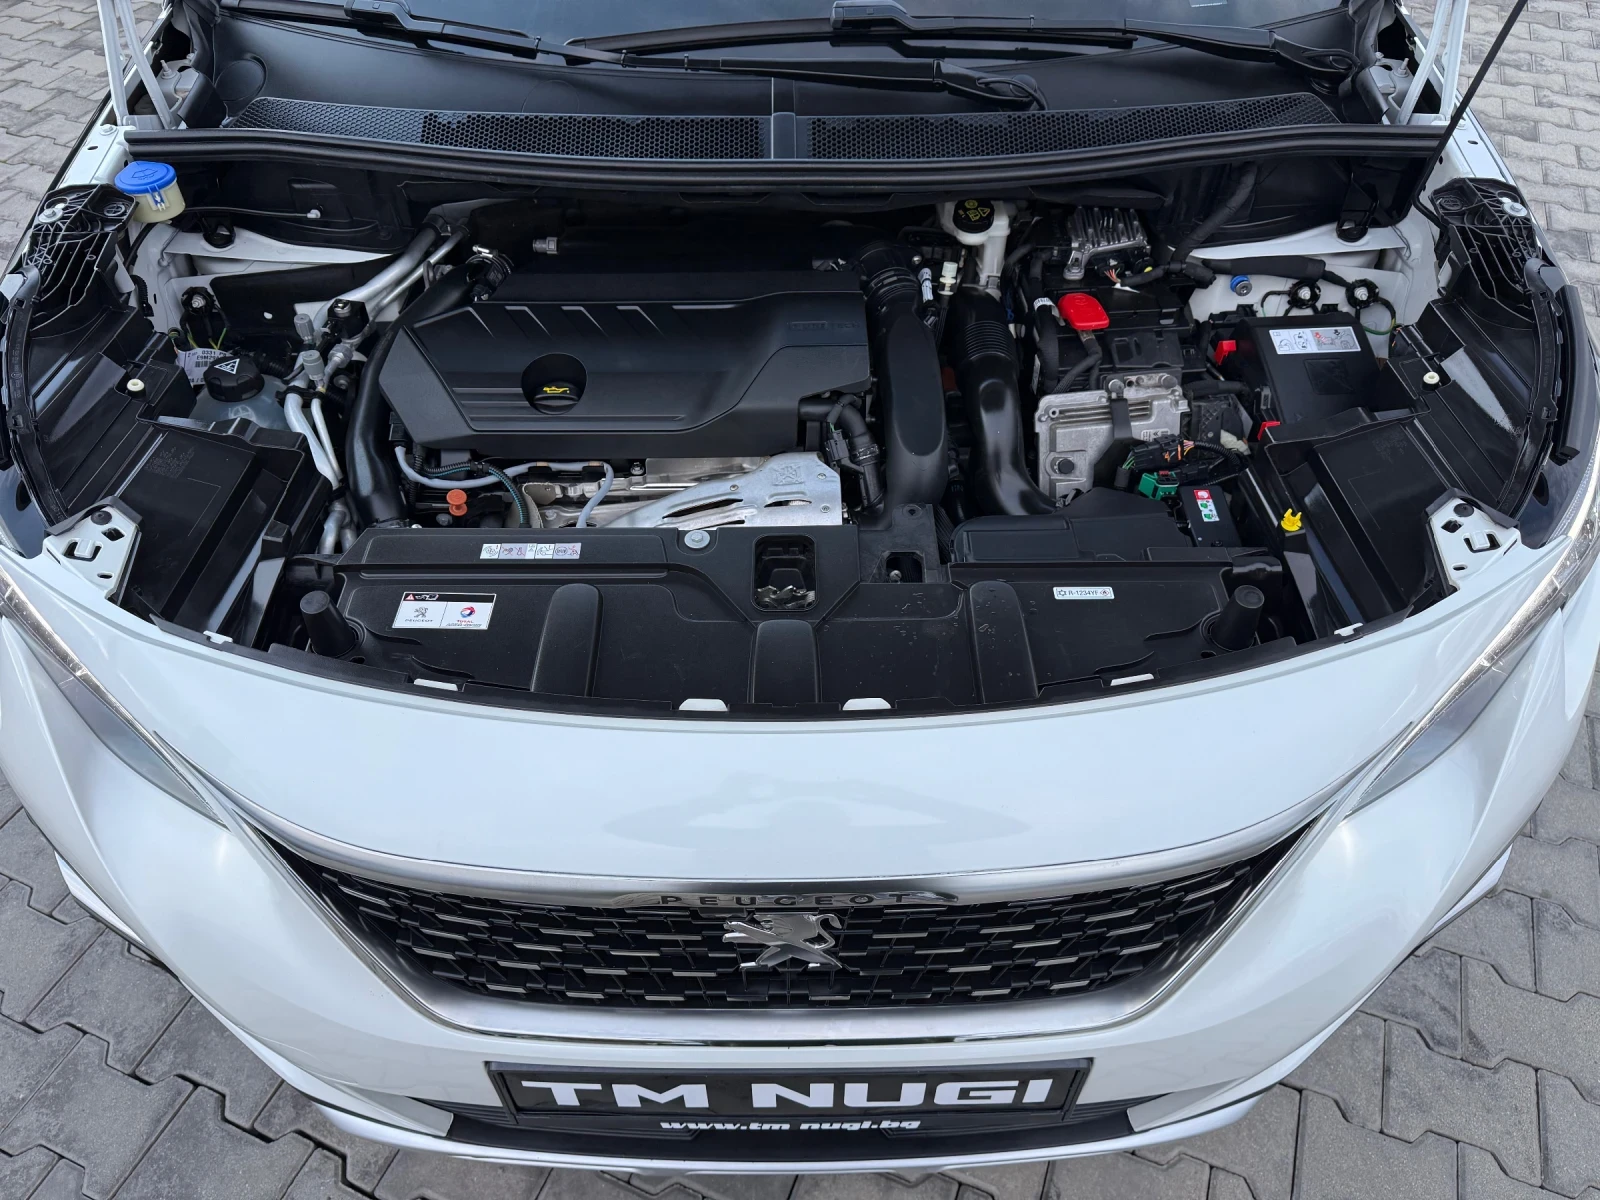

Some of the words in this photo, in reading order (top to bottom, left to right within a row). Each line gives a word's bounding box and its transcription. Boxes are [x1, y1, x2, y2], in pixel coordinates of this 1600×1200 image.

[660, 893, 911, 906] PEUGEOT
[521, 1080, 709, 1109] TM
[752, 1078, 1053, 1108] NUGI
